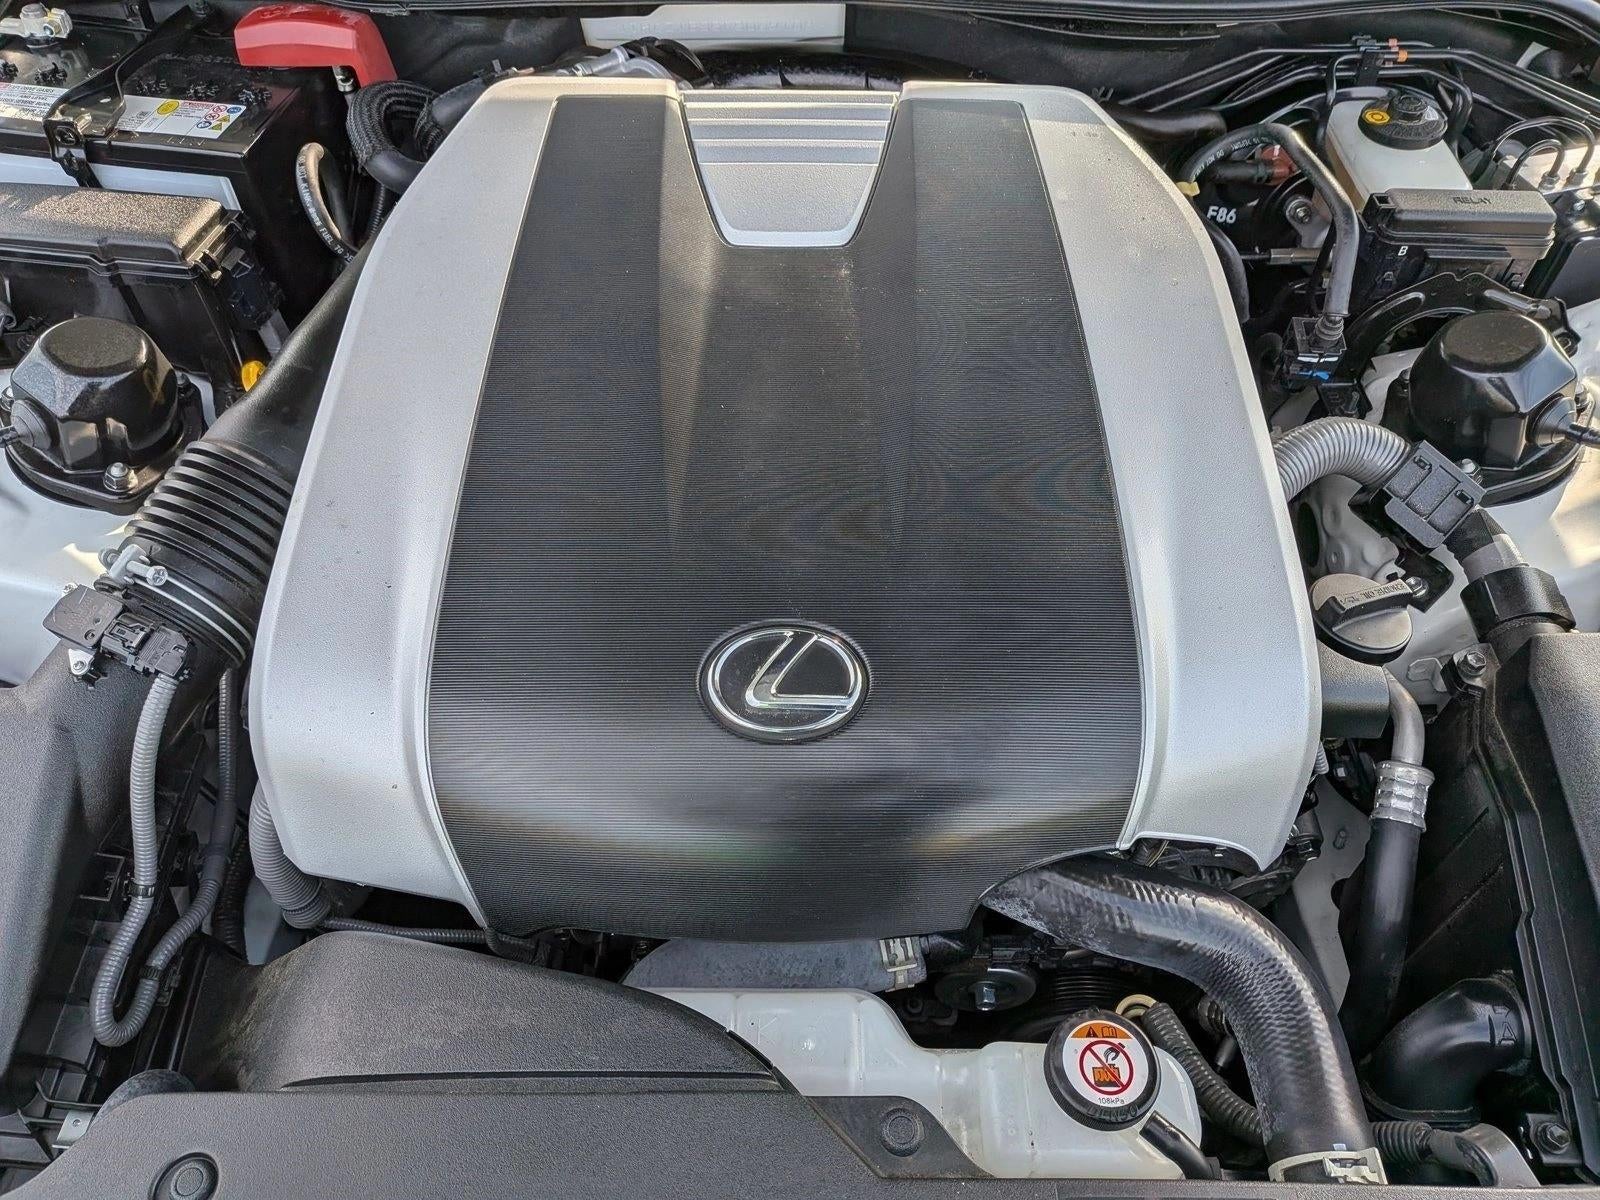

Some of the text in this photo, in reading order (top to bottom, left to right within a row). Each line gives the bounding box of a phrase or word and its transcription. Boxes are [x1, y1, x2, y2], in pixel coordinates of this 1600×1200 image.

[1452, 196, 1492, 205] RELAY
[1206, 205, 1238, 224] F86
[319, 227, 334, 245] FUEL
[1398, 245, 1409, 256] B
[1098, 1096, 1125, 1105] 108kPa
